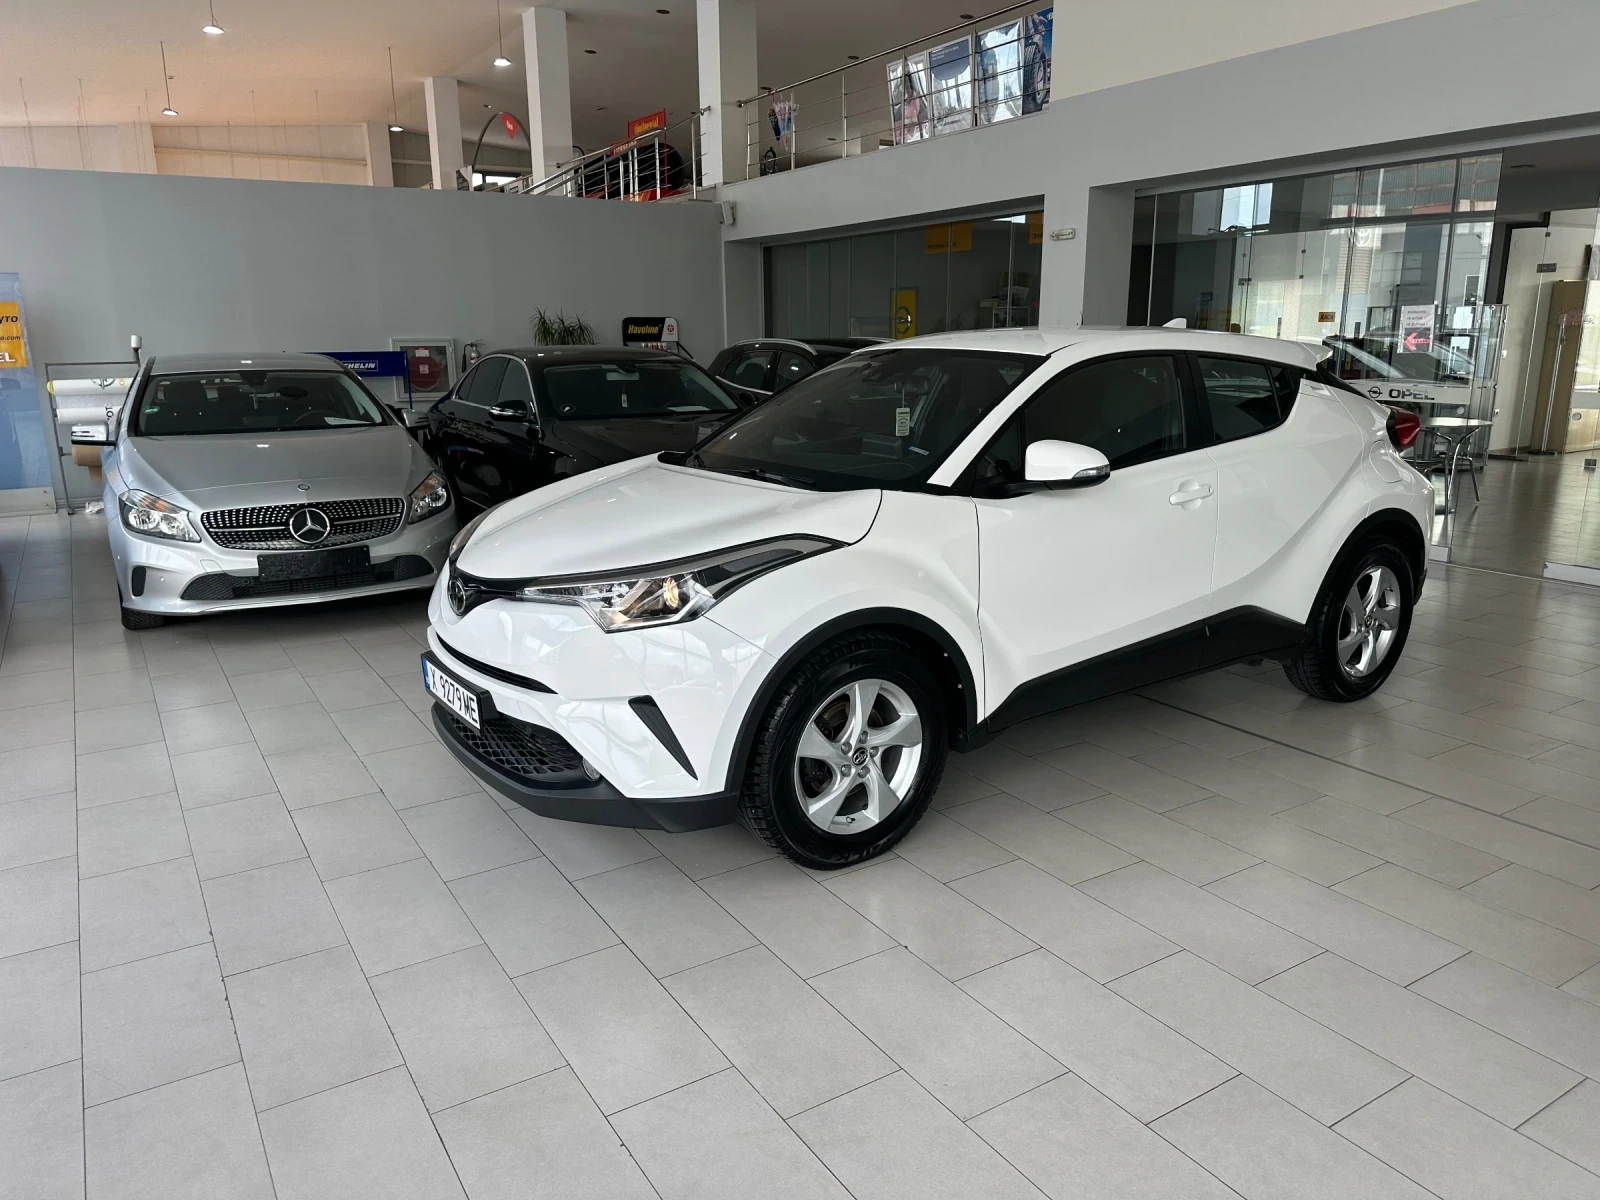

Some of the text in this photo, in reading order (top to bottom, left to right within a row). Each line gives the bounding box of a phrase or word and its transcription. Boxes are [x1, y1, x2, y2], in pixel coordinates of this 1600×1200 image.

[628, 324, 659, 334] Havoline
[1389, 388, 1435, 400] OPEL
[440, 675, 462, 711] 9279
[462, 691, 479, 725] ME
